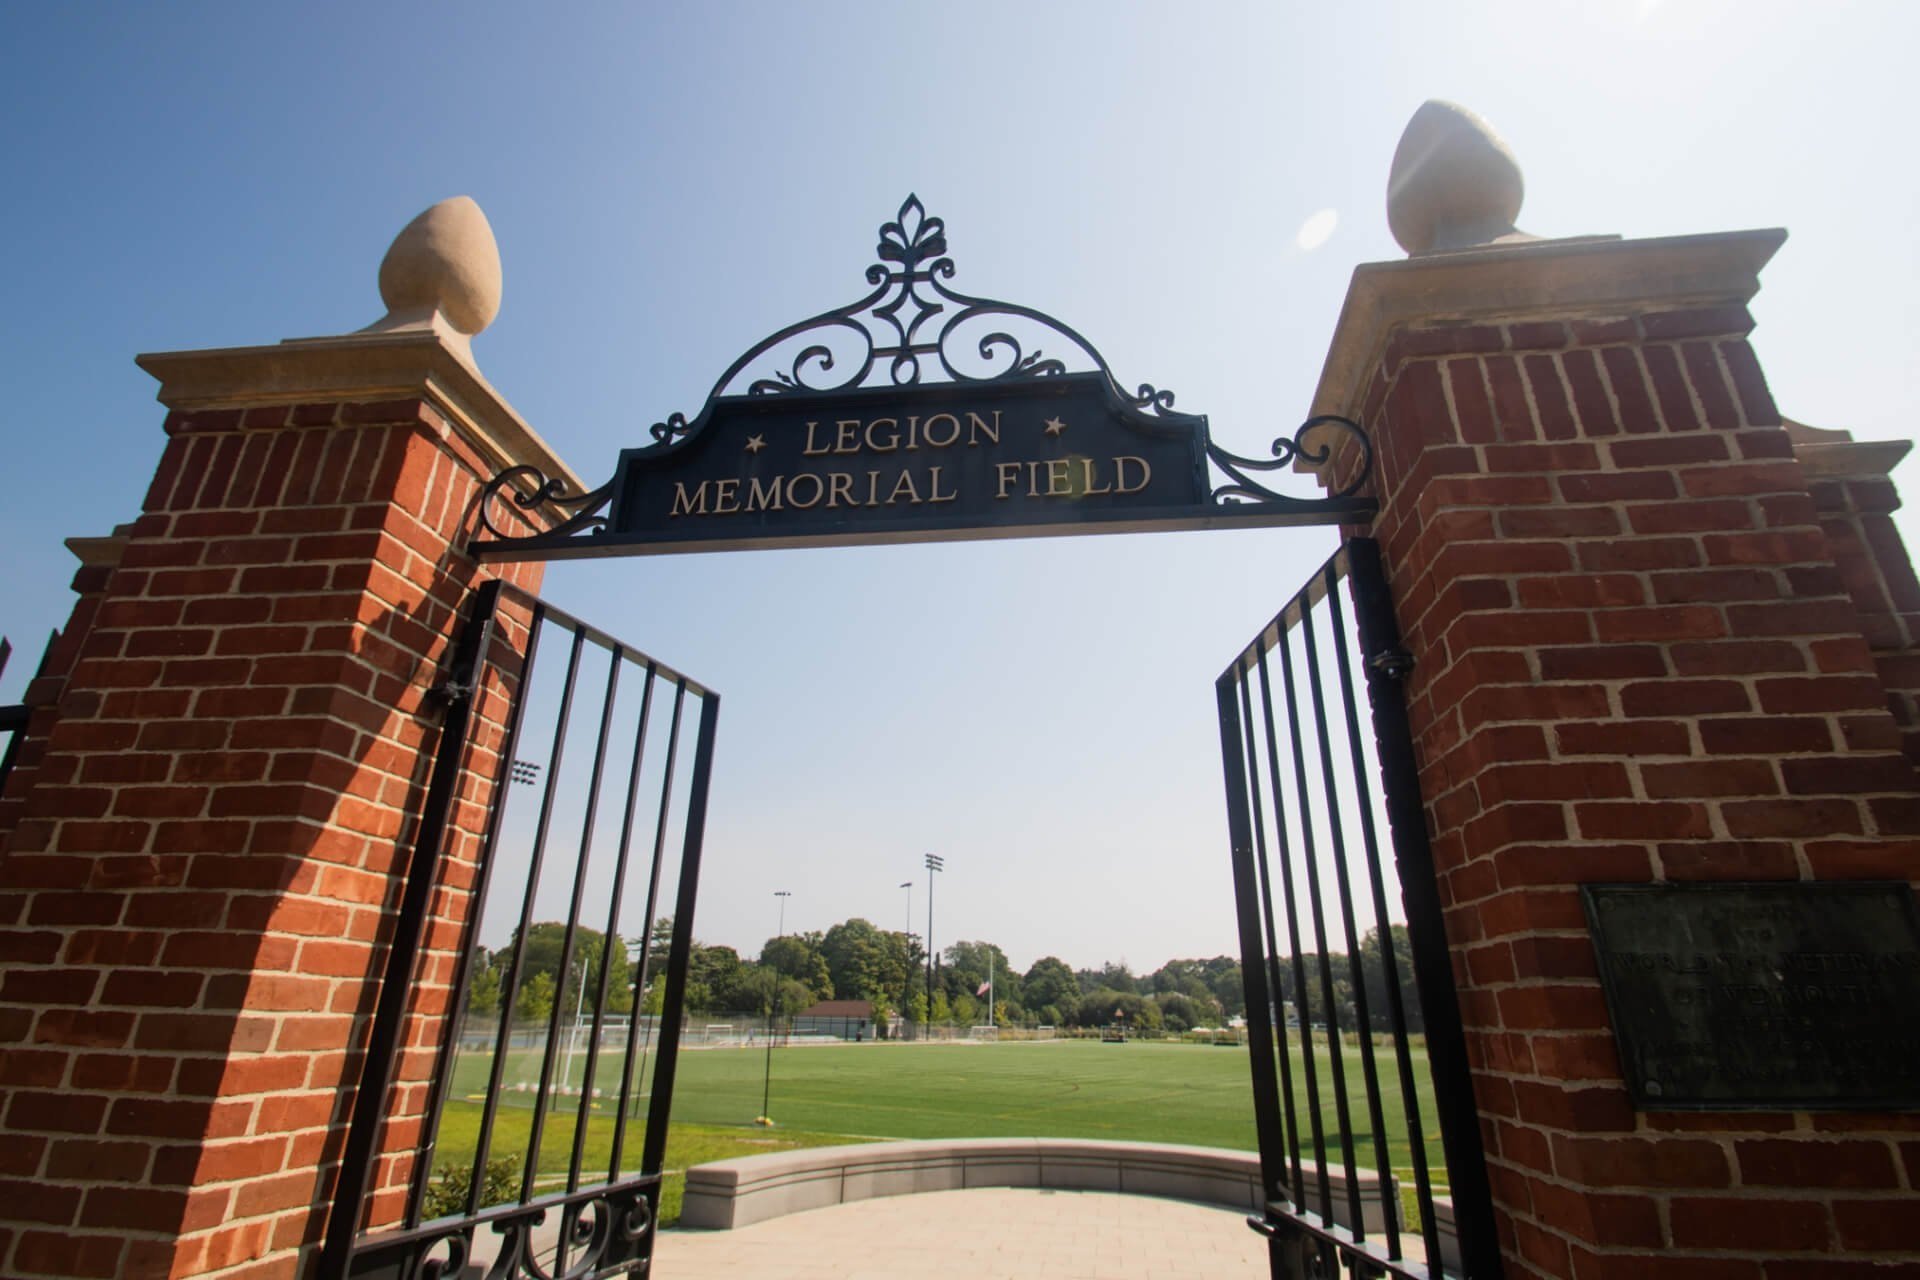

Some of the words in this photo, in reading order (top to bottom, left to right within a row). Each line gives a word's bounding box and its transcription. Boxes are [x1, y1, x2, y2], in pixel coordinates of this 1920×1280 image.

[803, 410, 1003, 455] LEGION
[669, 467, 957, 516] MEMORIAL
[995, 456, 1152, 499] FIELD
